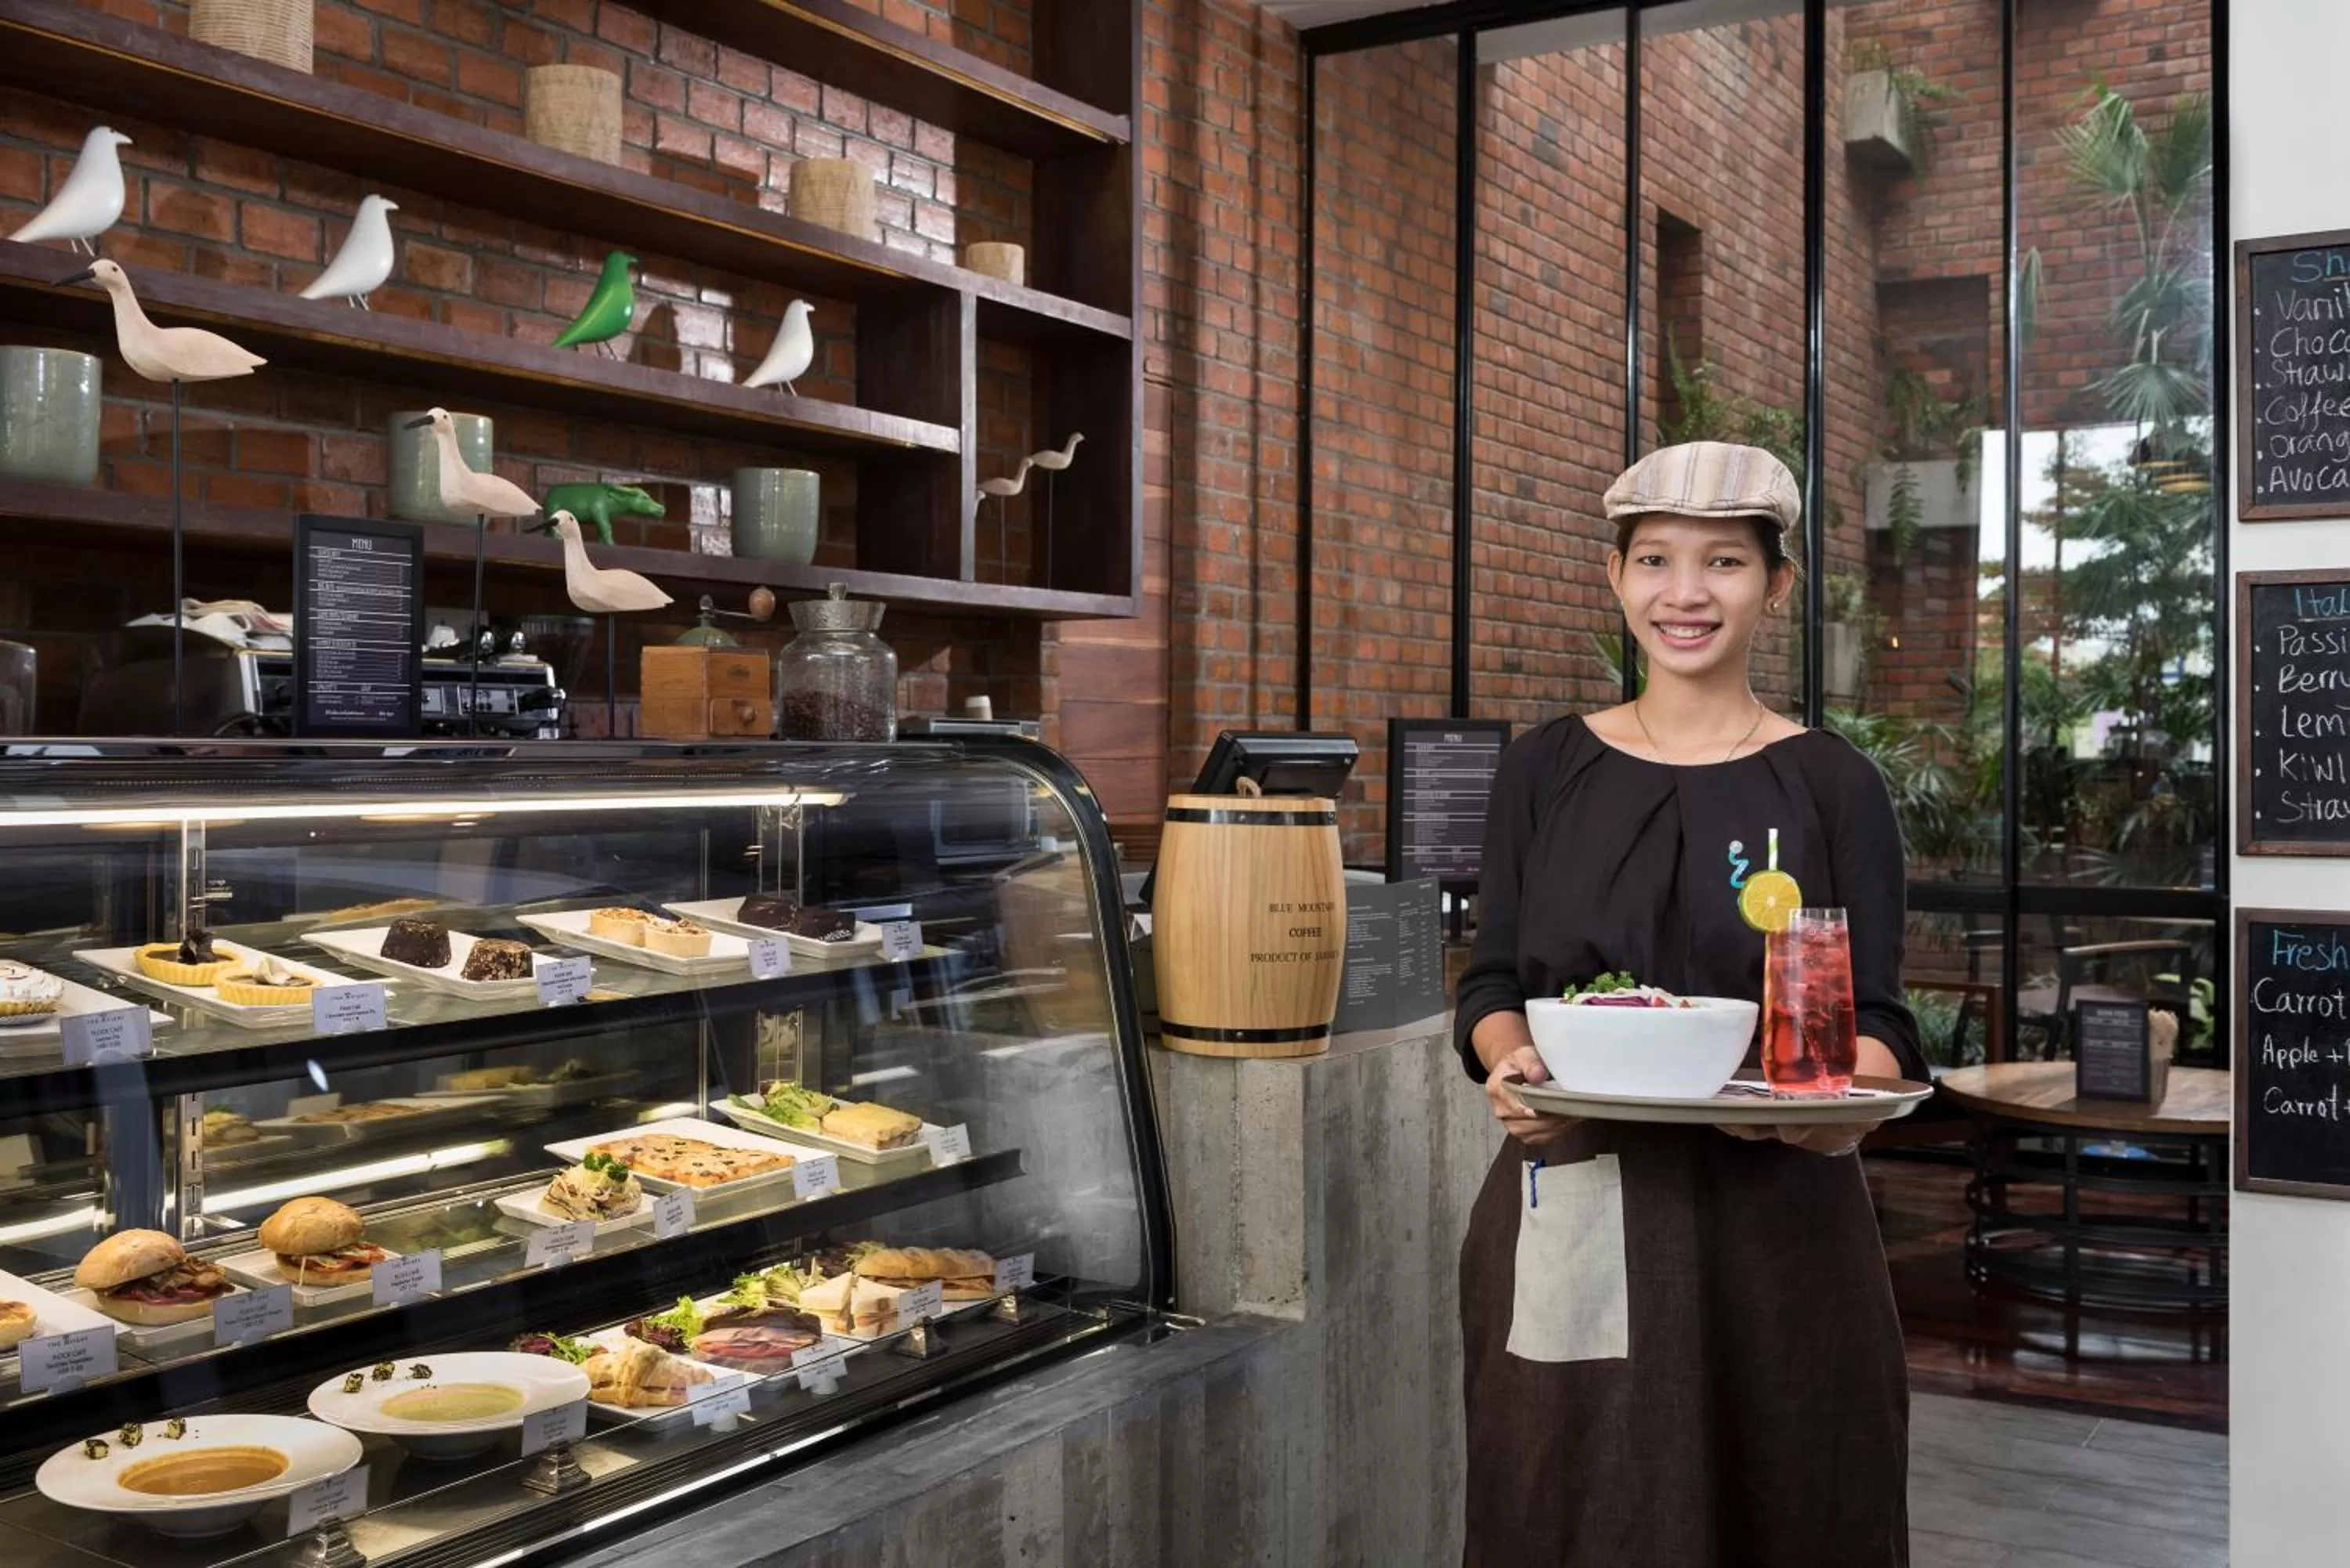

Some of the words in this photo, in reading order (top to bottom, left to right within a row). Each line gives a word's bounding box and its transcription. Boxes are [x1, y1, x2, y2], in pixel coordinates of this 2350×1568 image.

[2290, 251, 2350, 282] Sh
[2271, 358, 2350, 388] Straw
[2280, 704, 2350, 739] Lem
[1289, 927, 1322, 938] COFFEE
[1250, 952, 1297, 963] PRODUCT
[2272, 929, 2348, 970] Fresh
[2254, 977, 2348, 1021] Carrot
[2262, 1033, 2320, 1070] Apple
